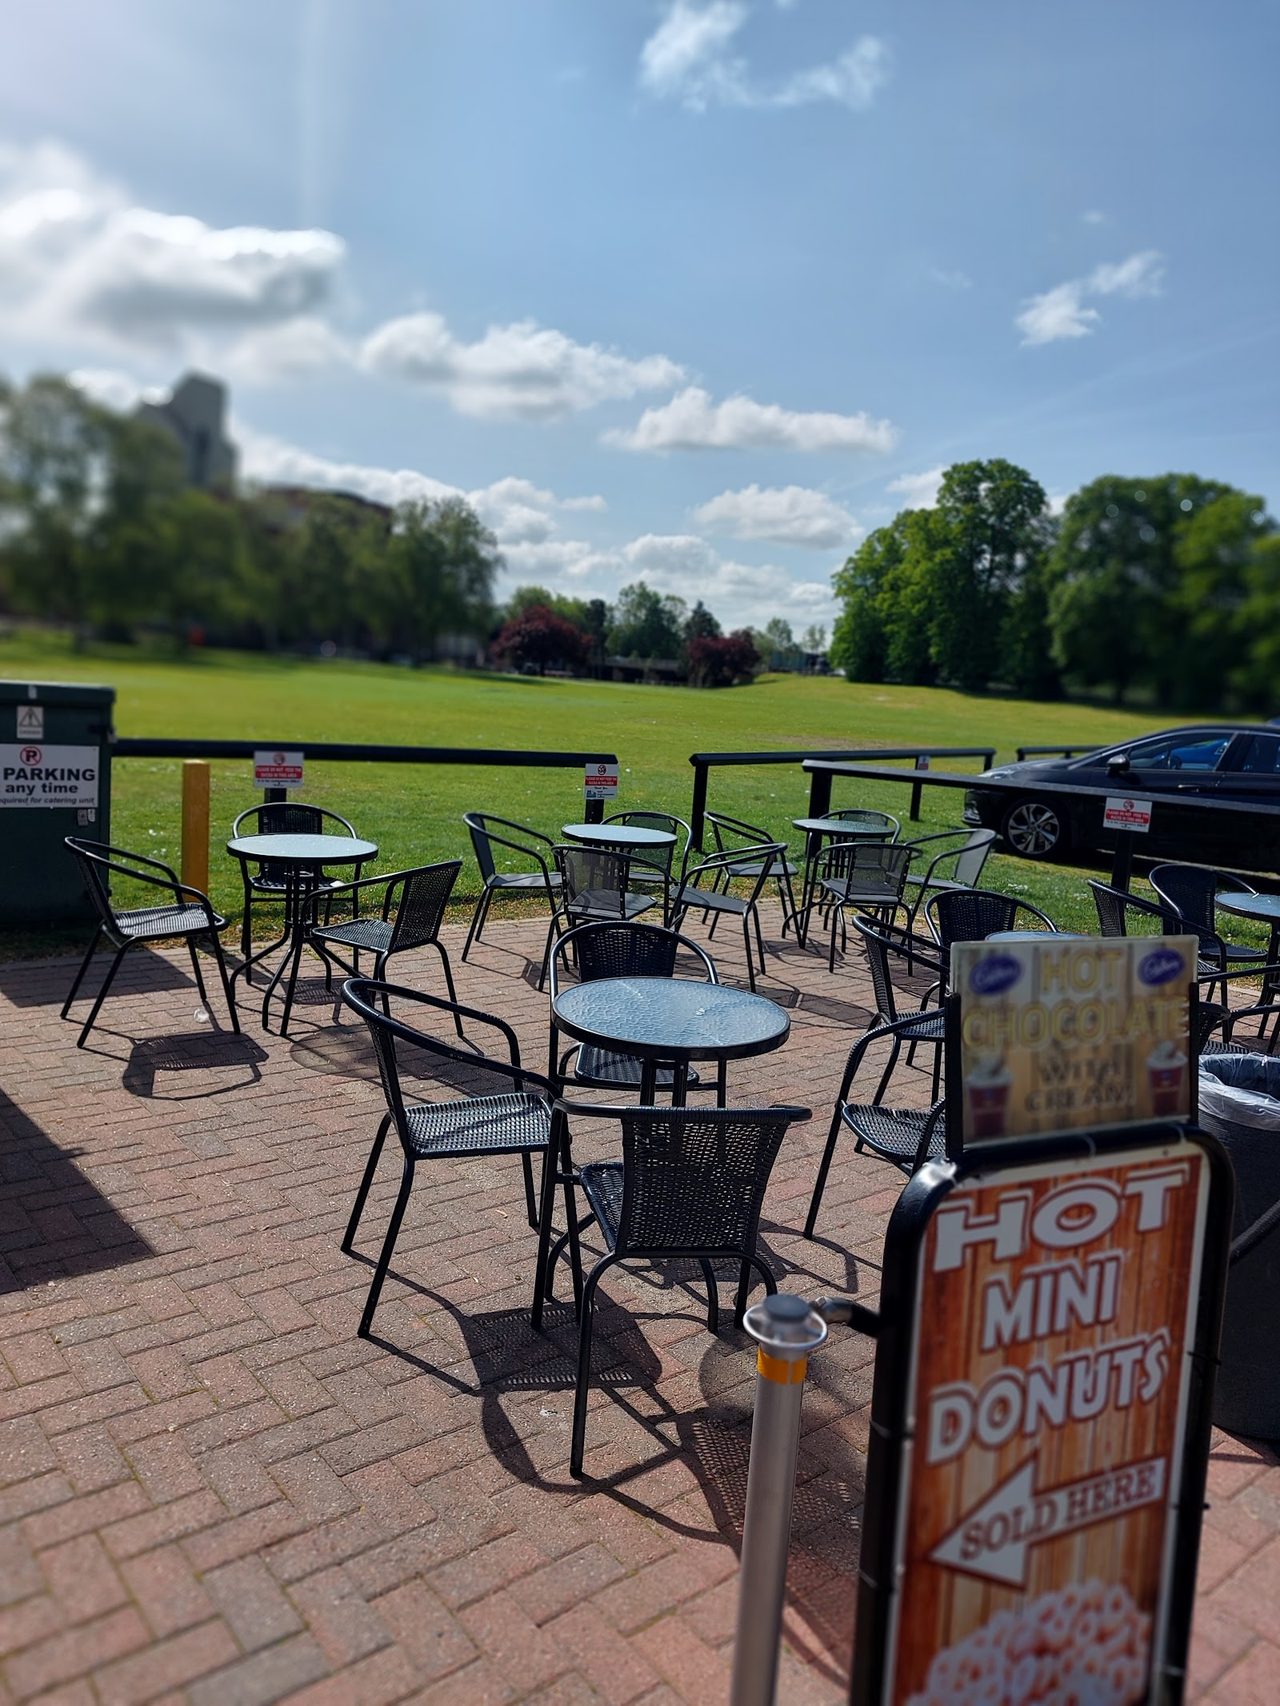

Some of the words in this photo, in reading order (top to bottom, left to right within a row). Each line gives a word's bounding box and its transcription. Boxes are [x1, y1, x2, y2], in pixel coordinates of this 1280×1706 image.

[3, 767, 96, 781] PARKING
[5, 784, 35, 796] any
[41, 782, 78, 793] time
[30, 796, 42, 804] for
[1040, 950, 1125, 993] HOT
[962, 995, 1189, 1048] CHOCOLATE
[933, 1168, 1187, 1273] HOT
[982, 1252, 1122, 1350] MINI
[927, 1334, 1169, 1466] DONUTS
[960, 1501, 1058, 1560] SOLD
[1066, 1464, 1156, 1524] HERE
